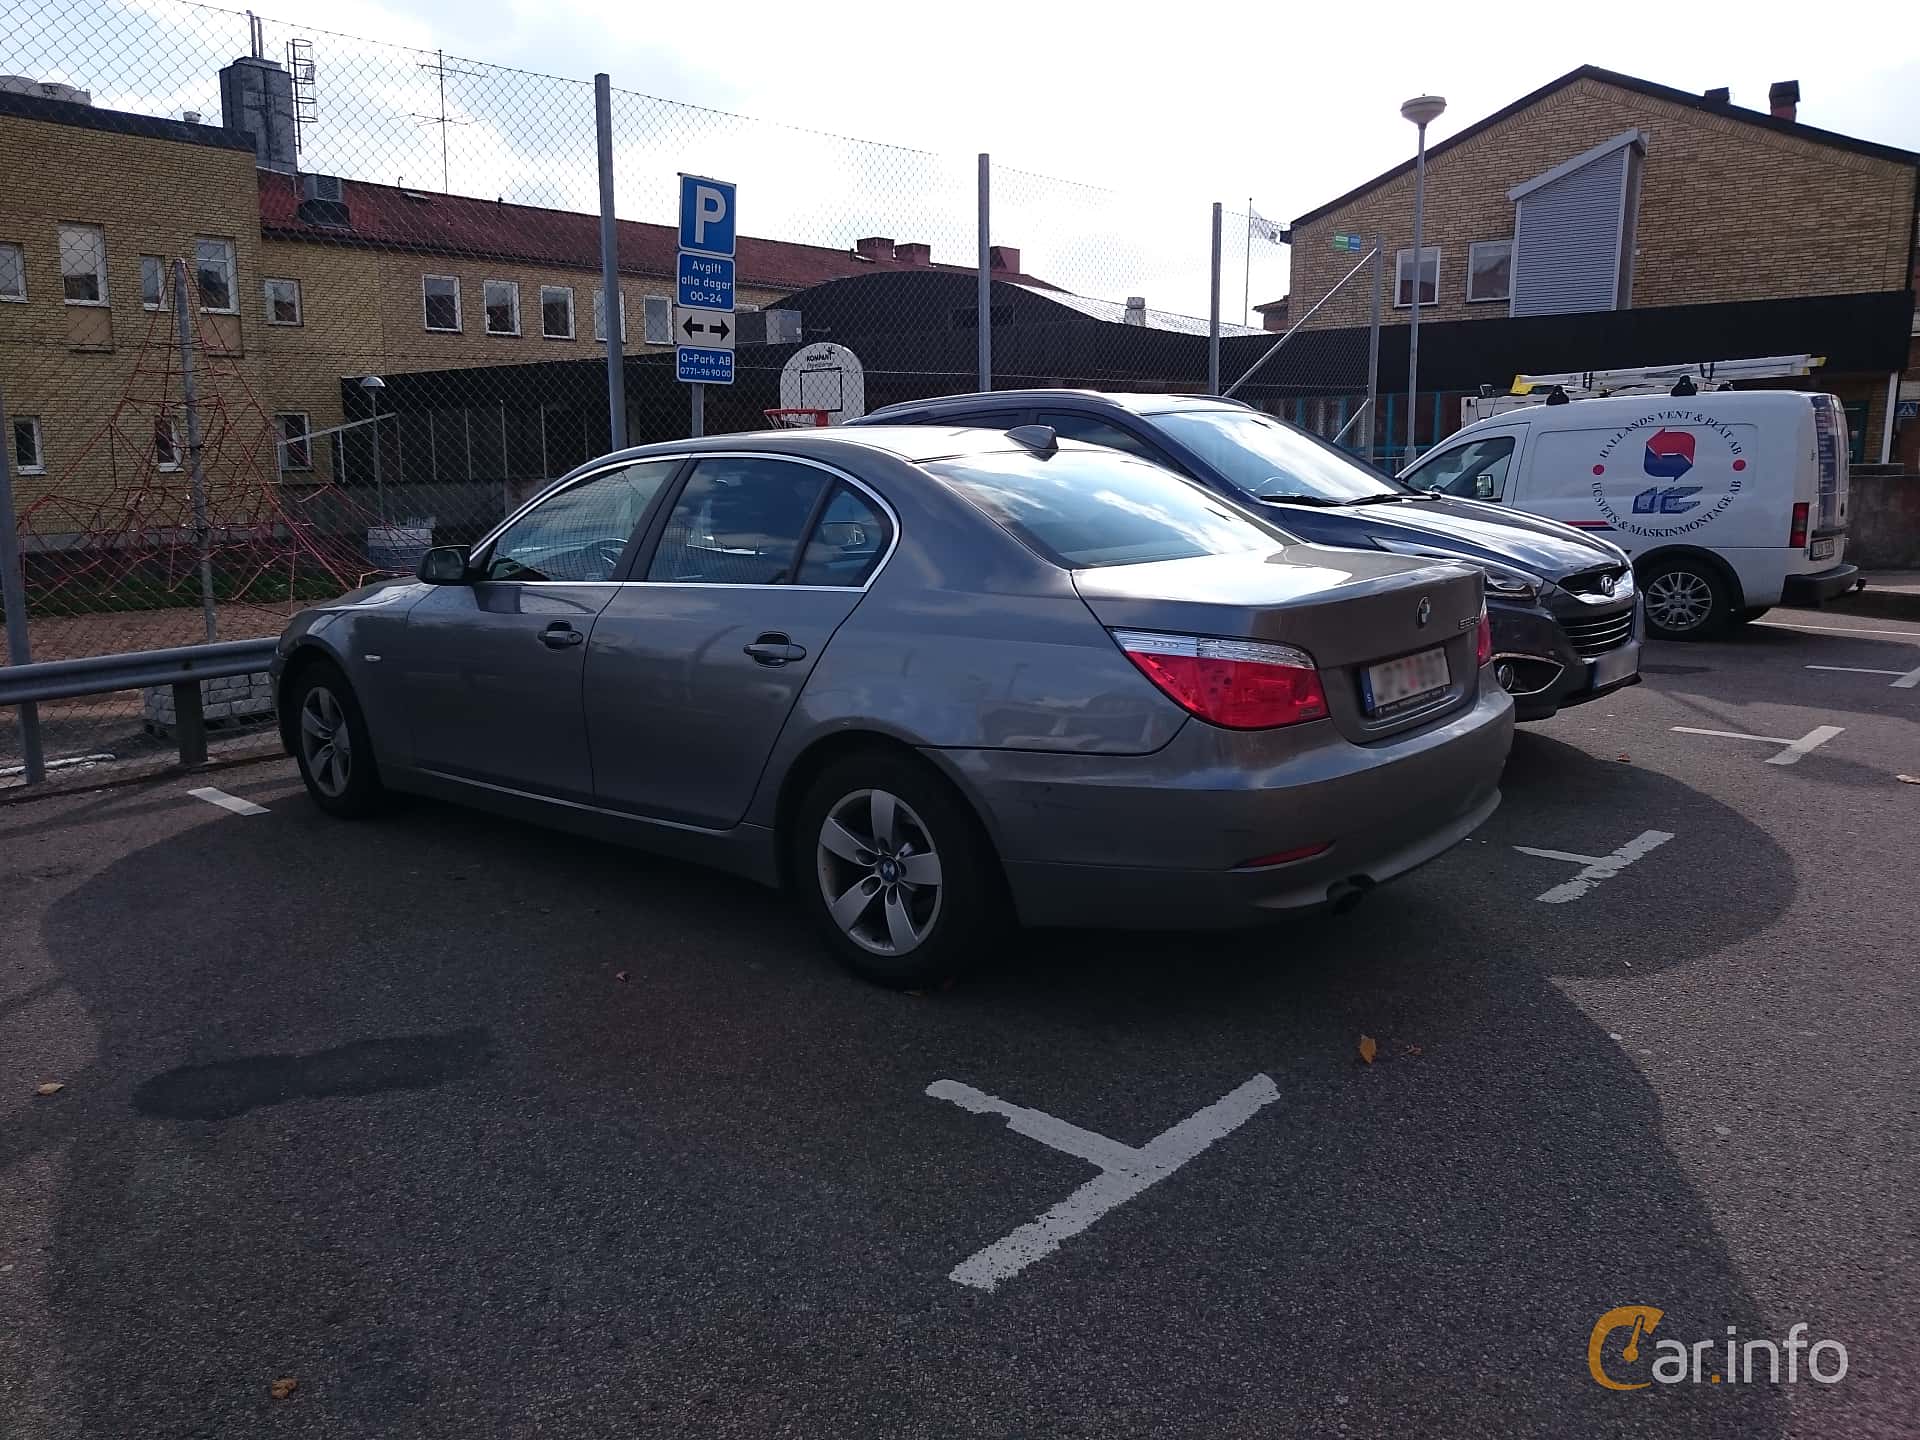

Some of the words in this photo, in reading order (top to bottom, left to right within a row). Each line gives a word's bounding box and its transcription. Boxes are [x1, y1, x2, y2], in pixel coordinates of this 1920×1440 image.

[695, 185, 727, 244] P
[692, 260, 722, 274] Avgift
[681, 276, 700, 286] alla
[703, 277, 732, 290] dagar
[690, 291, 722, 303] 00-24
[681, 353, 715, 365] Q-Park
[718, 356, 731, 365] AB
[1599, 414, 1655, 459] HALLANDS
[1657, 411, 1693, 420] VENT
[1694, 413, 1703, 423] &
[1728, 441, 1742, 455] AB
[1628, 495, 1735, 537] MASKINMONTAGE
[1728, 480, 1743, 496] AB
